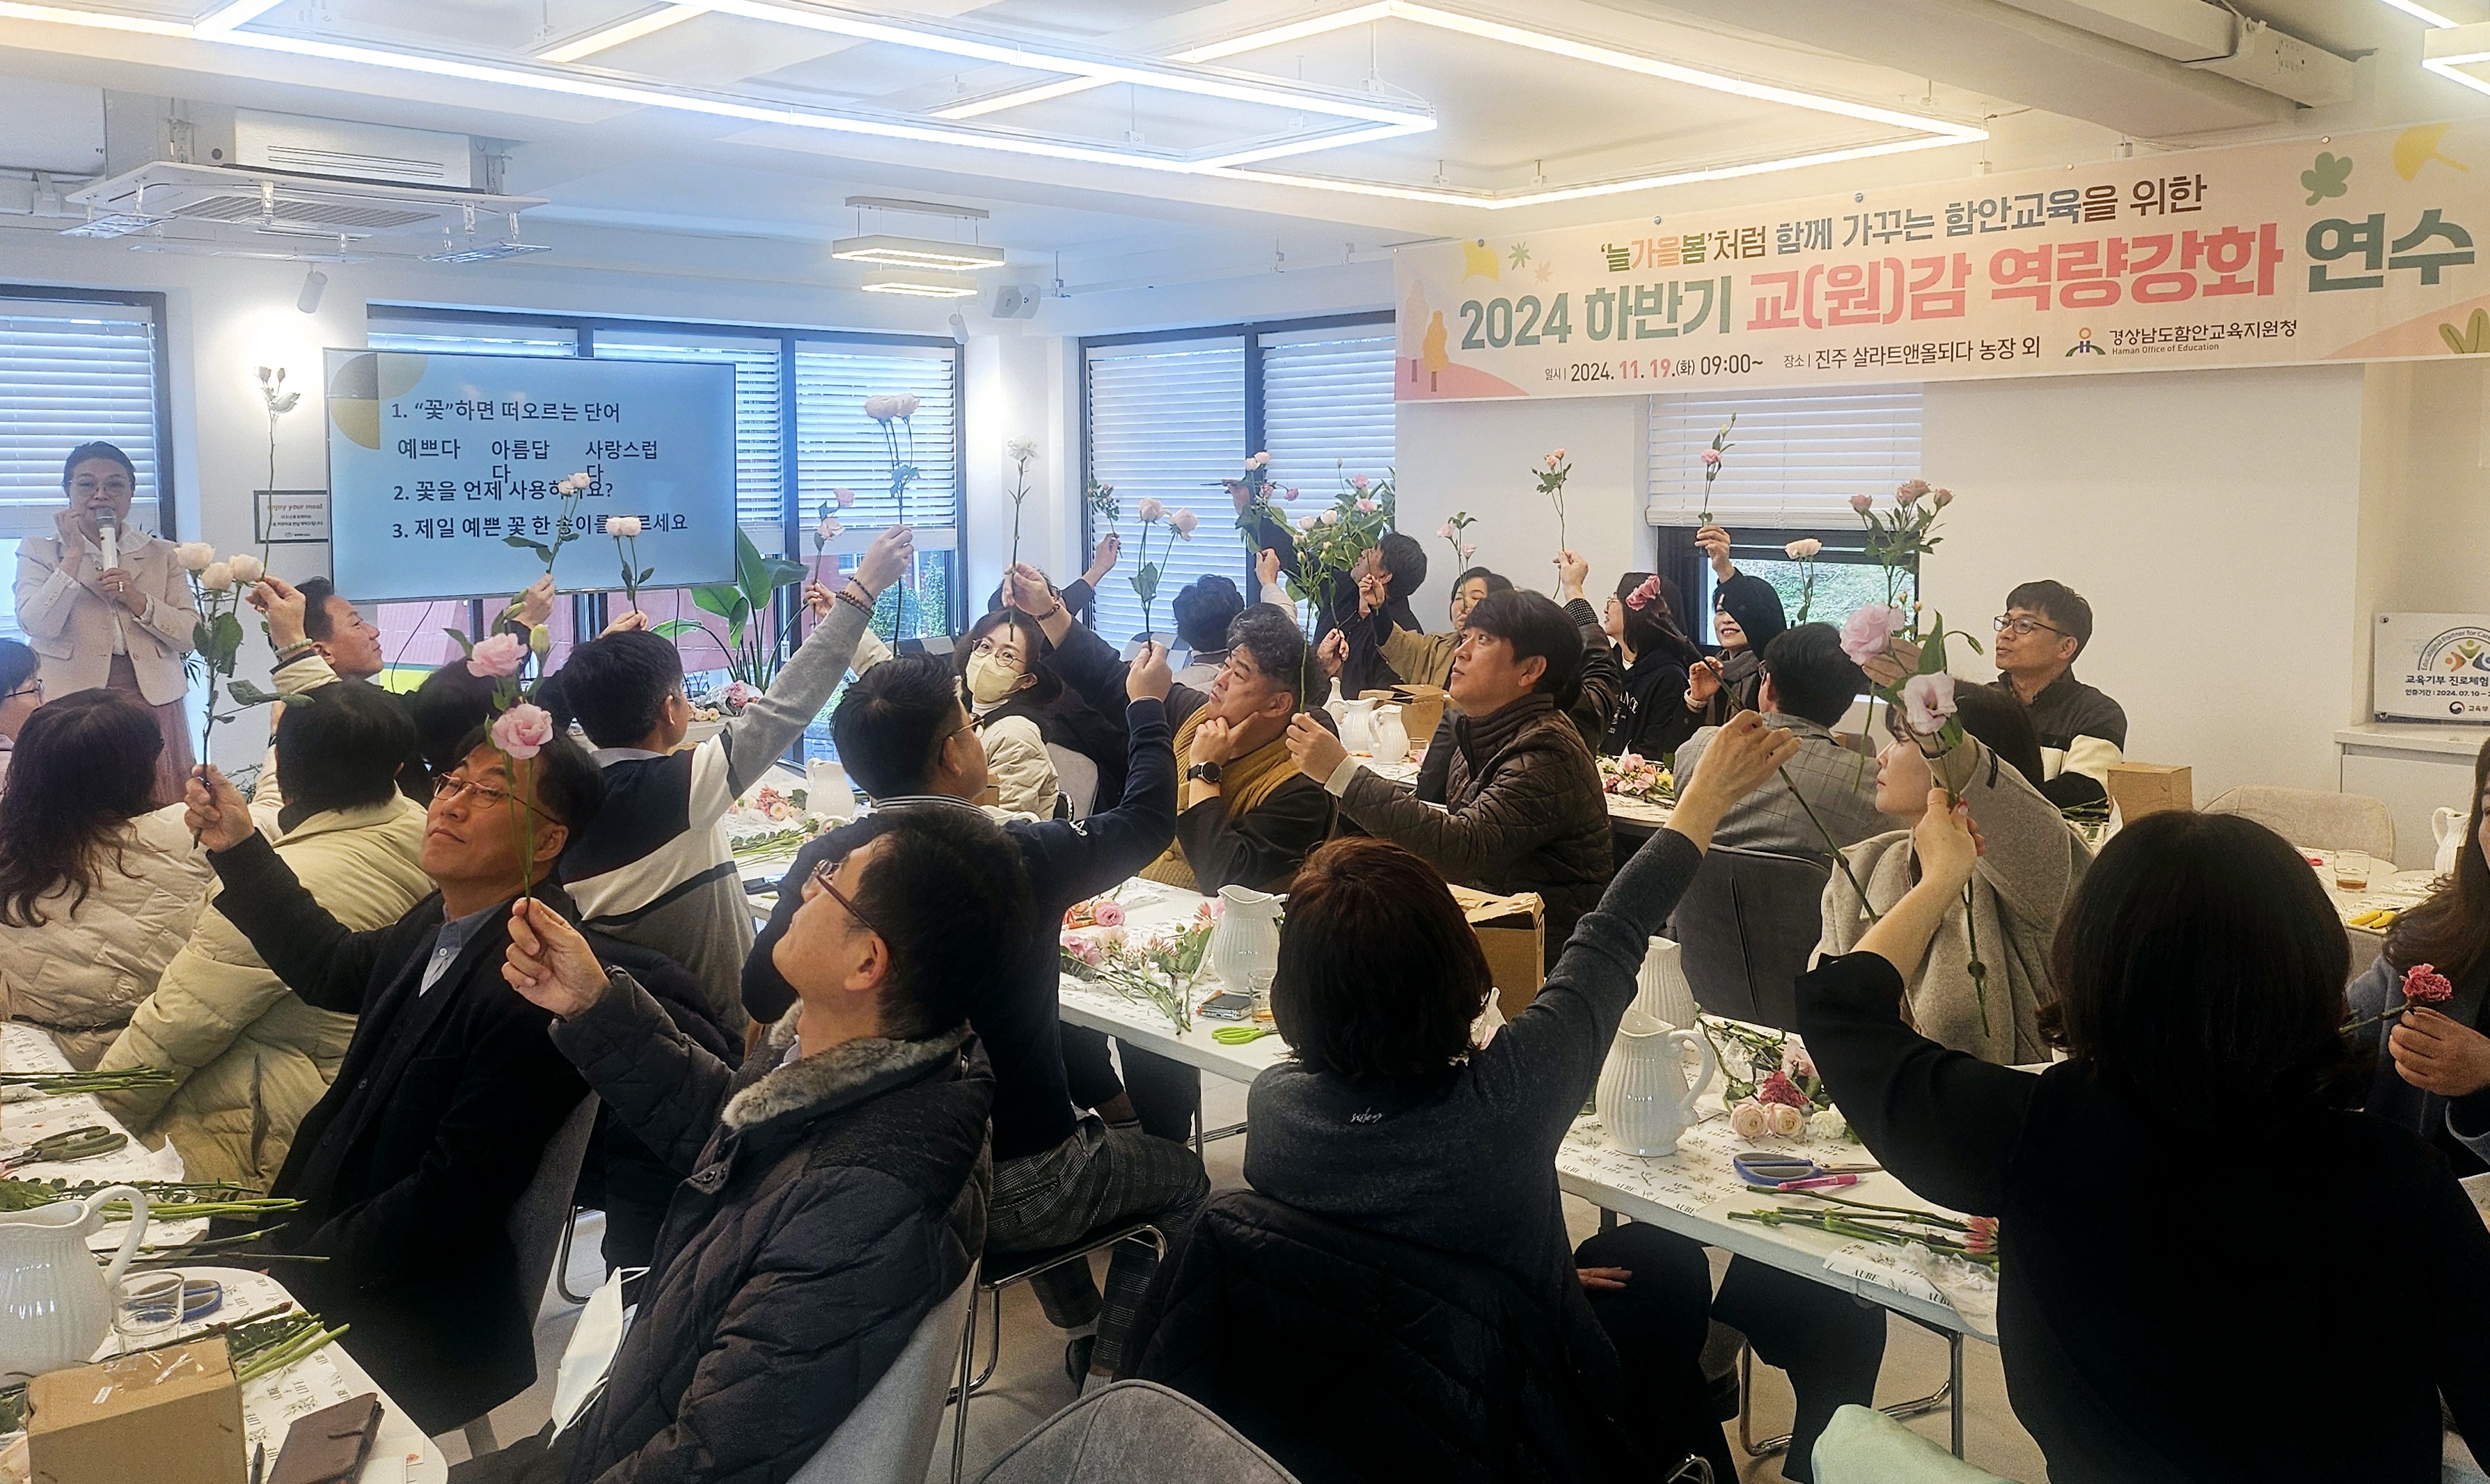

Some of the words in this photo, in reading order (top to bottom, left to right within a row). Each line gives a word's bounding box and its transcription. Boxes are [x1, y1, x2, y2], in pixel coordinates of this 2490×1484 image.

[1776, 217, 1833, 255] 함께
[1841, 207, 1934, 248] 가꾸는
[1946, 184, 2118, 237] 함안교육을
[2129, 174, 2207, 216] 위한
[1460, 292, 1572, 350] 2024
[1584, 276, 1731, 341] 하반기
[1747, 251, 1971, 331] 교(원)감
[1989, 223, 2283, 313] 역량강화
[2305, 208, 2475, 292] 연수
[2109, 319, 2297, 346] 경상남도함안교육지원청
[2177, 343, 2219, 352] Education
[1545, 368, 1561, 381] 일시
[1570, 362, 1614, 382] 2024.
[1619, 360, 1645, 379] 11.
[1701, 353, 1764, 375] 09:00~
[1783, 354, 1805, 369] 장소
[1815, 348, 1848, 370] 진주
[1852, 340, 1973, 367] 살라트앤올되다
[1979, 337, 2017, 360] 농장
[2022, 335, 2041, 358] 외
[392, 403, 407, 418] 1.
[502, 401, 578, 422] 떠오르는
[585, 402, 619, 423] 단어
[397, 438, 461, 459] 예쁘다
[491, 439, 550, 460] 아름답
[585, 440, 657, 460] 사랑스럽
[492, 463, 511, 484] 다
[393, 486, 409, 500] 2.
[416, 480, 457, 501] 꽃을
[464, 480, 502, 500] 언제
[393, 523, 409, 538] 3.
[415, 517, 455, 539] 제일
[462, 517, 501, 537] 예쁜
[507, 516, 526, 536] 꽃
[532, 516, 551, 535] 한
[2405, 674, 2446, 686] 교육기부
[2449, 676, 2489, 687] 진로체험
[1852, 1268, 1880, 1282] AUBE
